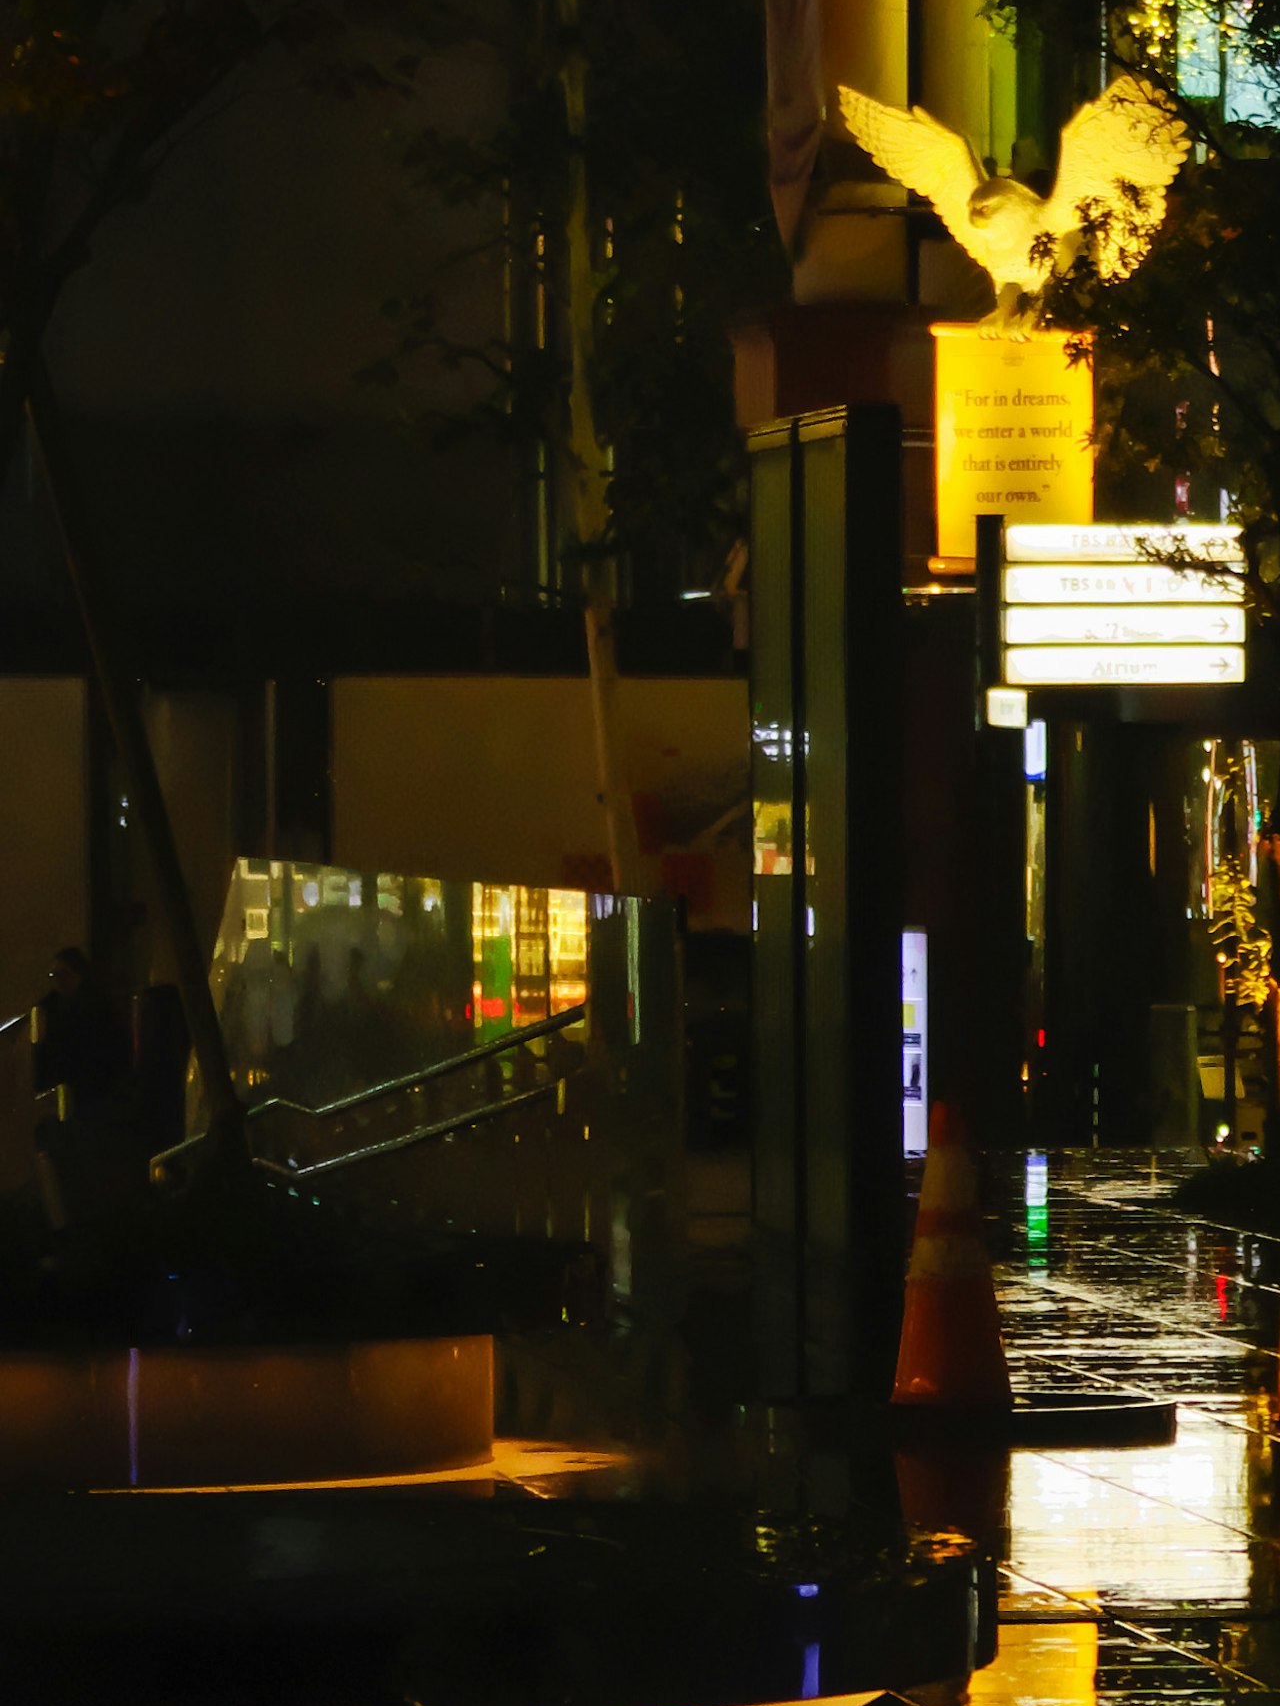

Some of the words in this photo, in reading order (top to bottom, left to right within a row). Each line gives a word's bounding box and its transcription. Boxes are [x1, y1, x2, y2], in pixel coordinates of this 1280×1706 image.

[994, 390, 1007, 407] in
[1012, 388, 1071, 408] dreams,
[953, 427, 974, 439] we
[977, 426, 1014, 439] enter
[1018, 427, 1026, 439] a
[1029, 420, 1073, 439] world
[963, 453, 991, 472] that
[995, 455, 1006, 472] is
[1008, 453, 1063, 476] entirely
[976, 491, 1002, 503] our
[1071, 534, 1100, 549] TBS
[1059, 577, 1090, 592] TBS
[1092, 660, 1158, 677] Atrium
